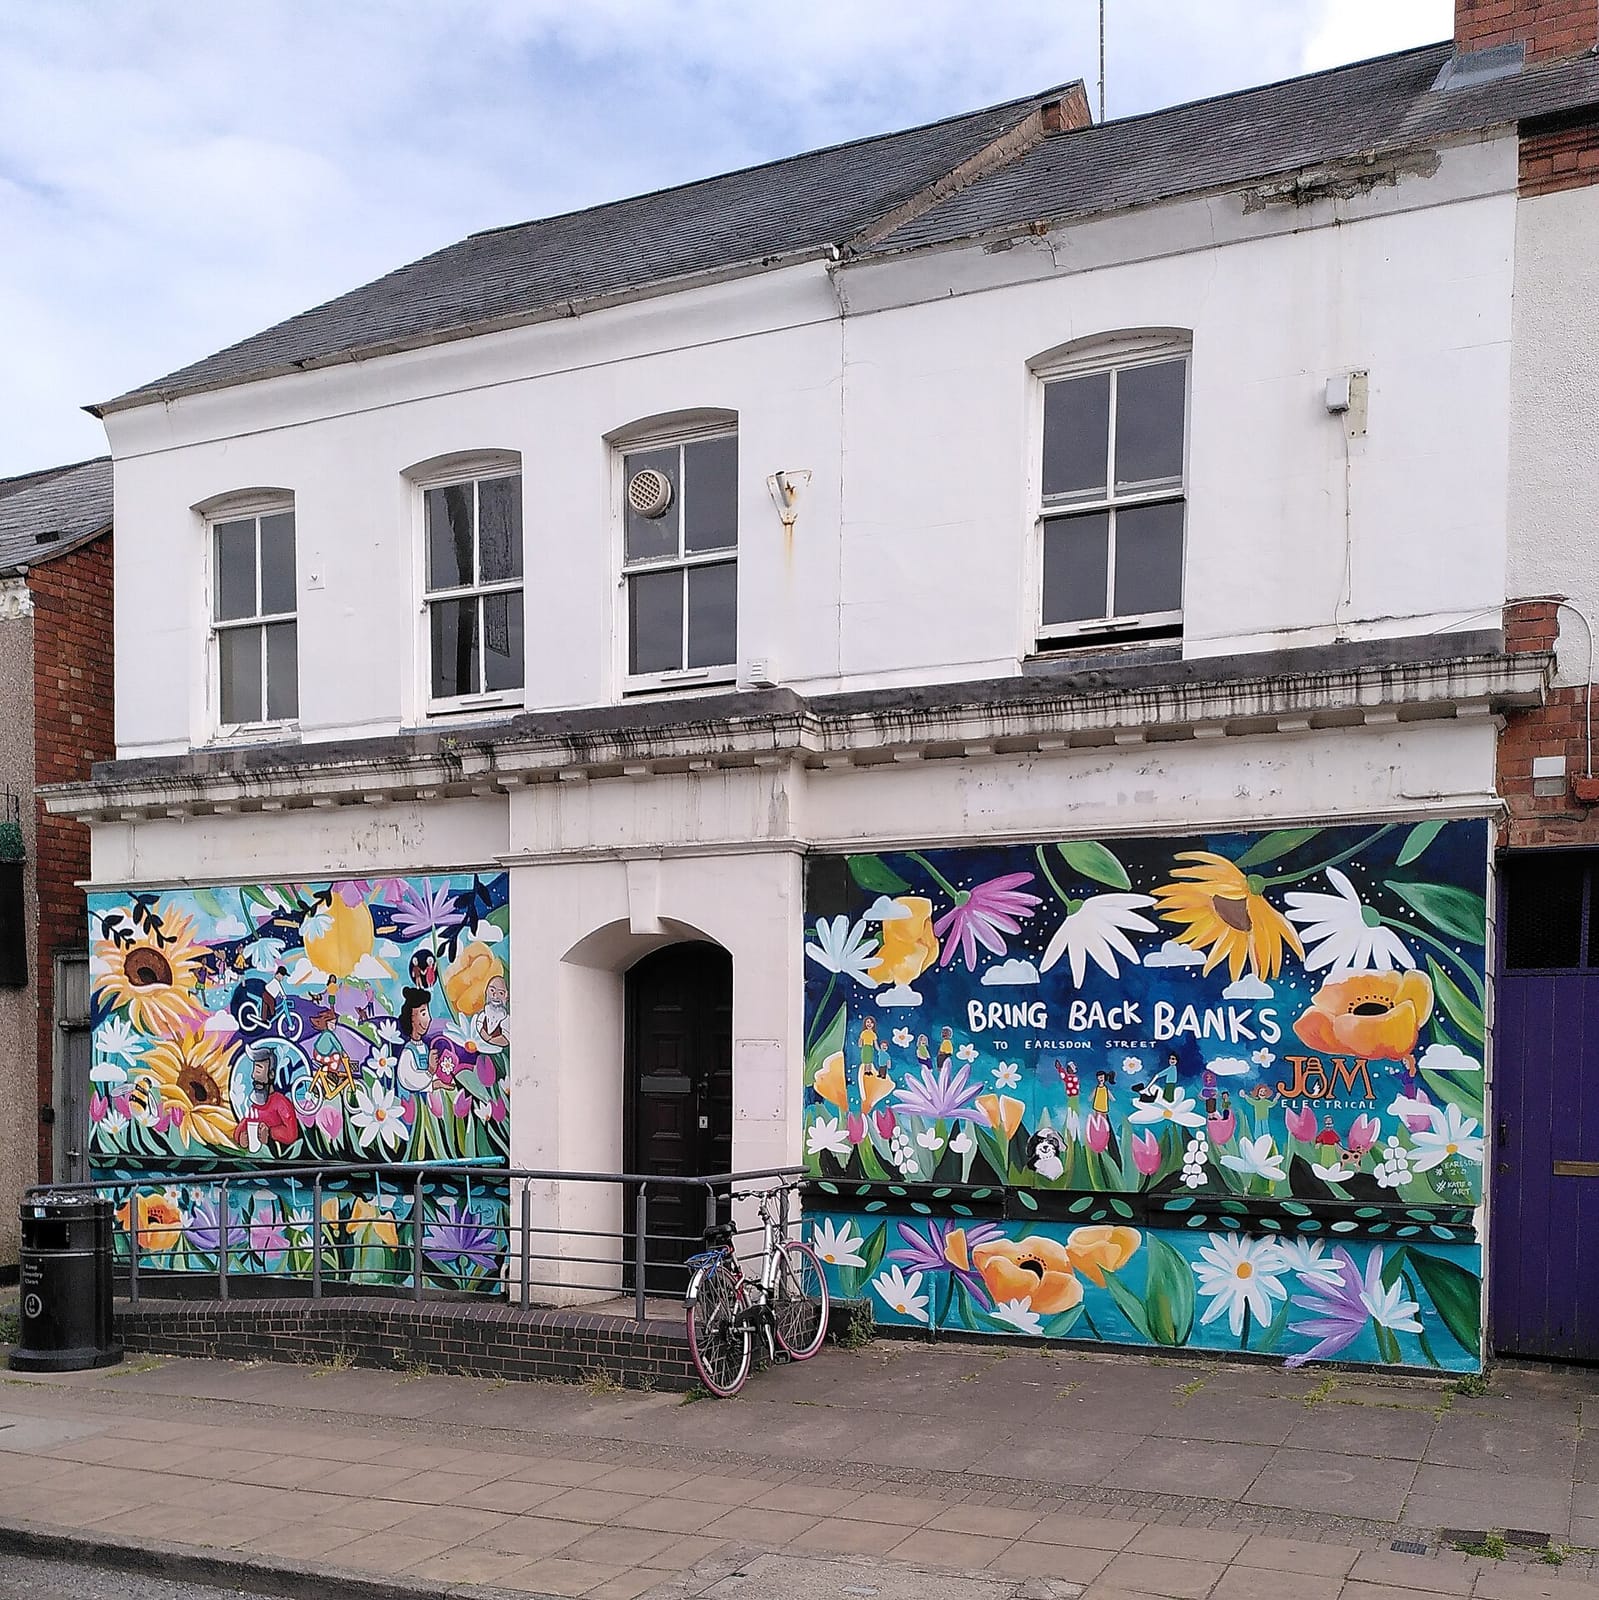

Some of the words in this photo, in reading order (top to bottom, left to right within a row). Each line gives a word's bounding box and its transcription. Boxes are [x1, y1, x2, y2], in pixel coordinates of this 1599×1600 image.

[967, 999, 1048, 1032] BRING
[1068, 1000, 1142, 1031] BACK
[1154, 1001, 1281, 1044] BANKS
[993, 1040, 1008, 1050] TO
[1025, 1040, 1091, 1049] EARLSDON
[1105, 1040, 1157, 1049] STREET
[1281, 1099, 1376, 1110] ELECTRICAL
